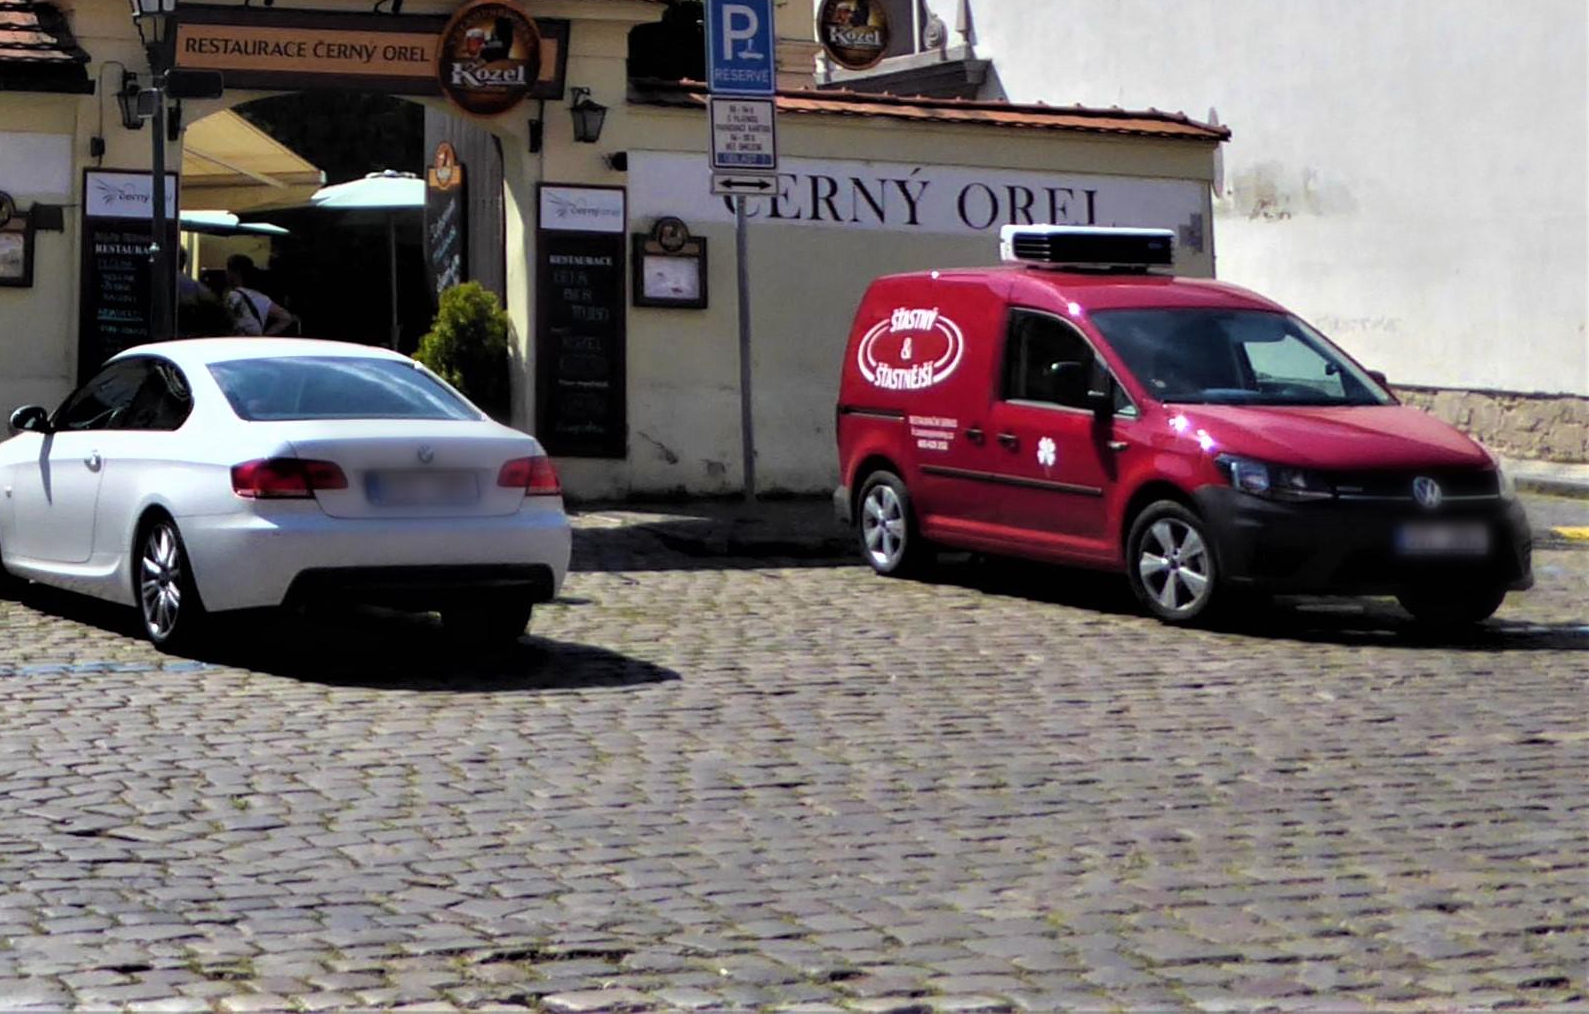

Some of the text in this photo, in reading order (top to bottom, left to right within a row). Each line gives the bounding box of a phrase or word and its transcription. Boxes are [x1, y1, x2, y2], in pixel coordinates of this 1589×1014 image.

[722, 3, 758, 61] P
[828, 26, 881, 46] Kozel
[184, 37, 307, 59] RESTAURACE
[382, 44, 430, 63] OREL
[451, 63, 526, 86] Kozel
[900, 337, 912, 360] &
